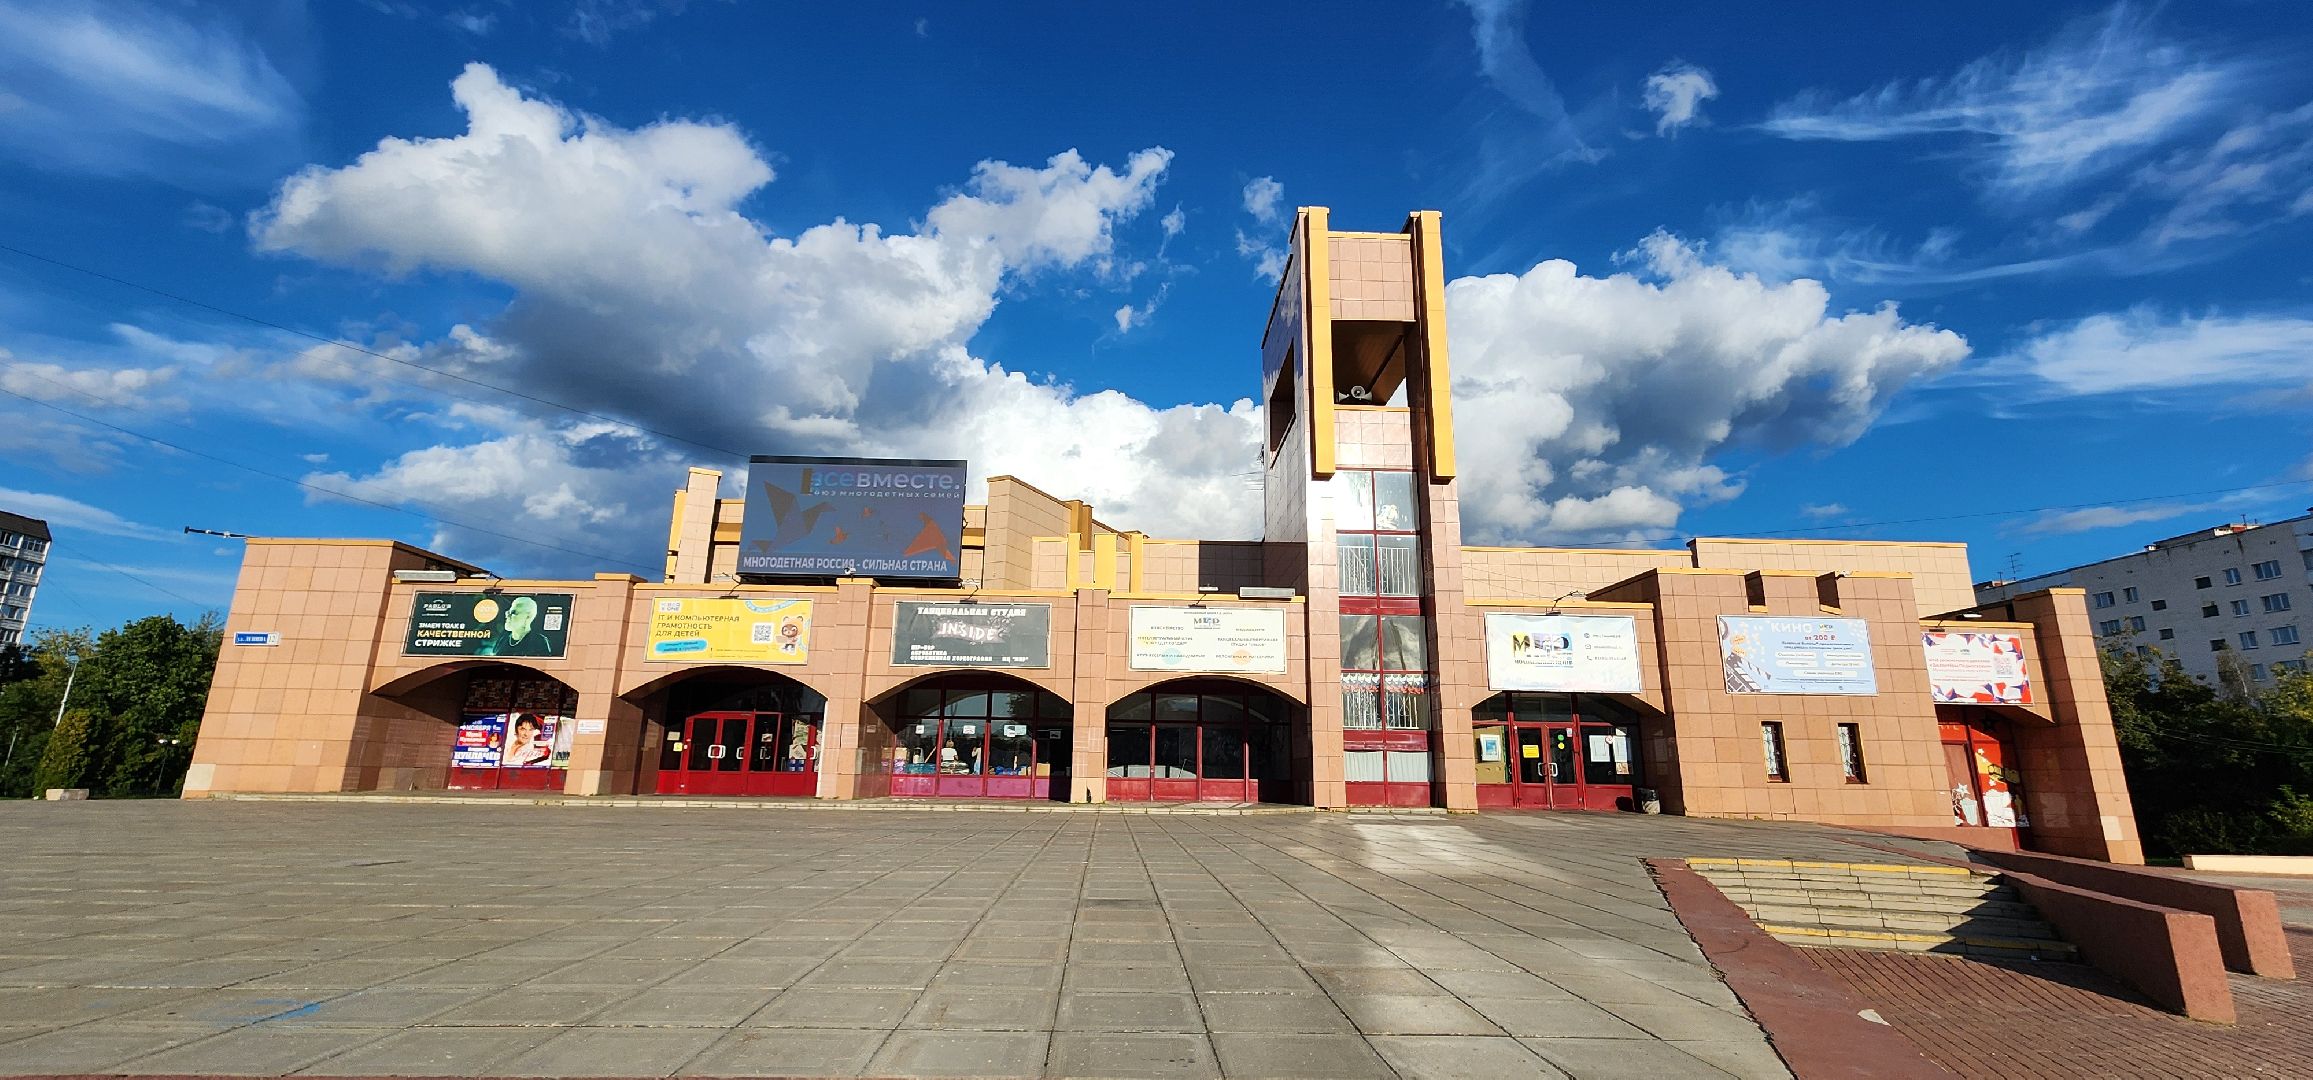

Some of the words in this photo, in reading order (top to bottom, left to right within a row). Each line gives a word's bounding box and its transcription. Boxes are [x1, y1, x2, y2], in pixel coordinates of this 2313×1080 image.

[839, 490, 920, 498] многодетных
[743, 556, 814, 569] МНОГОДЕТНАЯ
[816, 557, 855, 570] РОССИЯ
[862, 558, 907, 571] СИЛЬНАЯ
[909, 559, 947, 572] СТРАНА
[917, 606, 988, 616] ТАНЦЕВАЛЬНАЯ
[990, 608, 1026, 617] СТУДИЯ
[416, 629, 491, 638] КАЧЕСТВЕННОЙ
[937, 621, 997, 641] INSIDE
[1769, 622, 1812, 634] КИНО
[414, 639, 463, 647] СТРИЖКЕ
